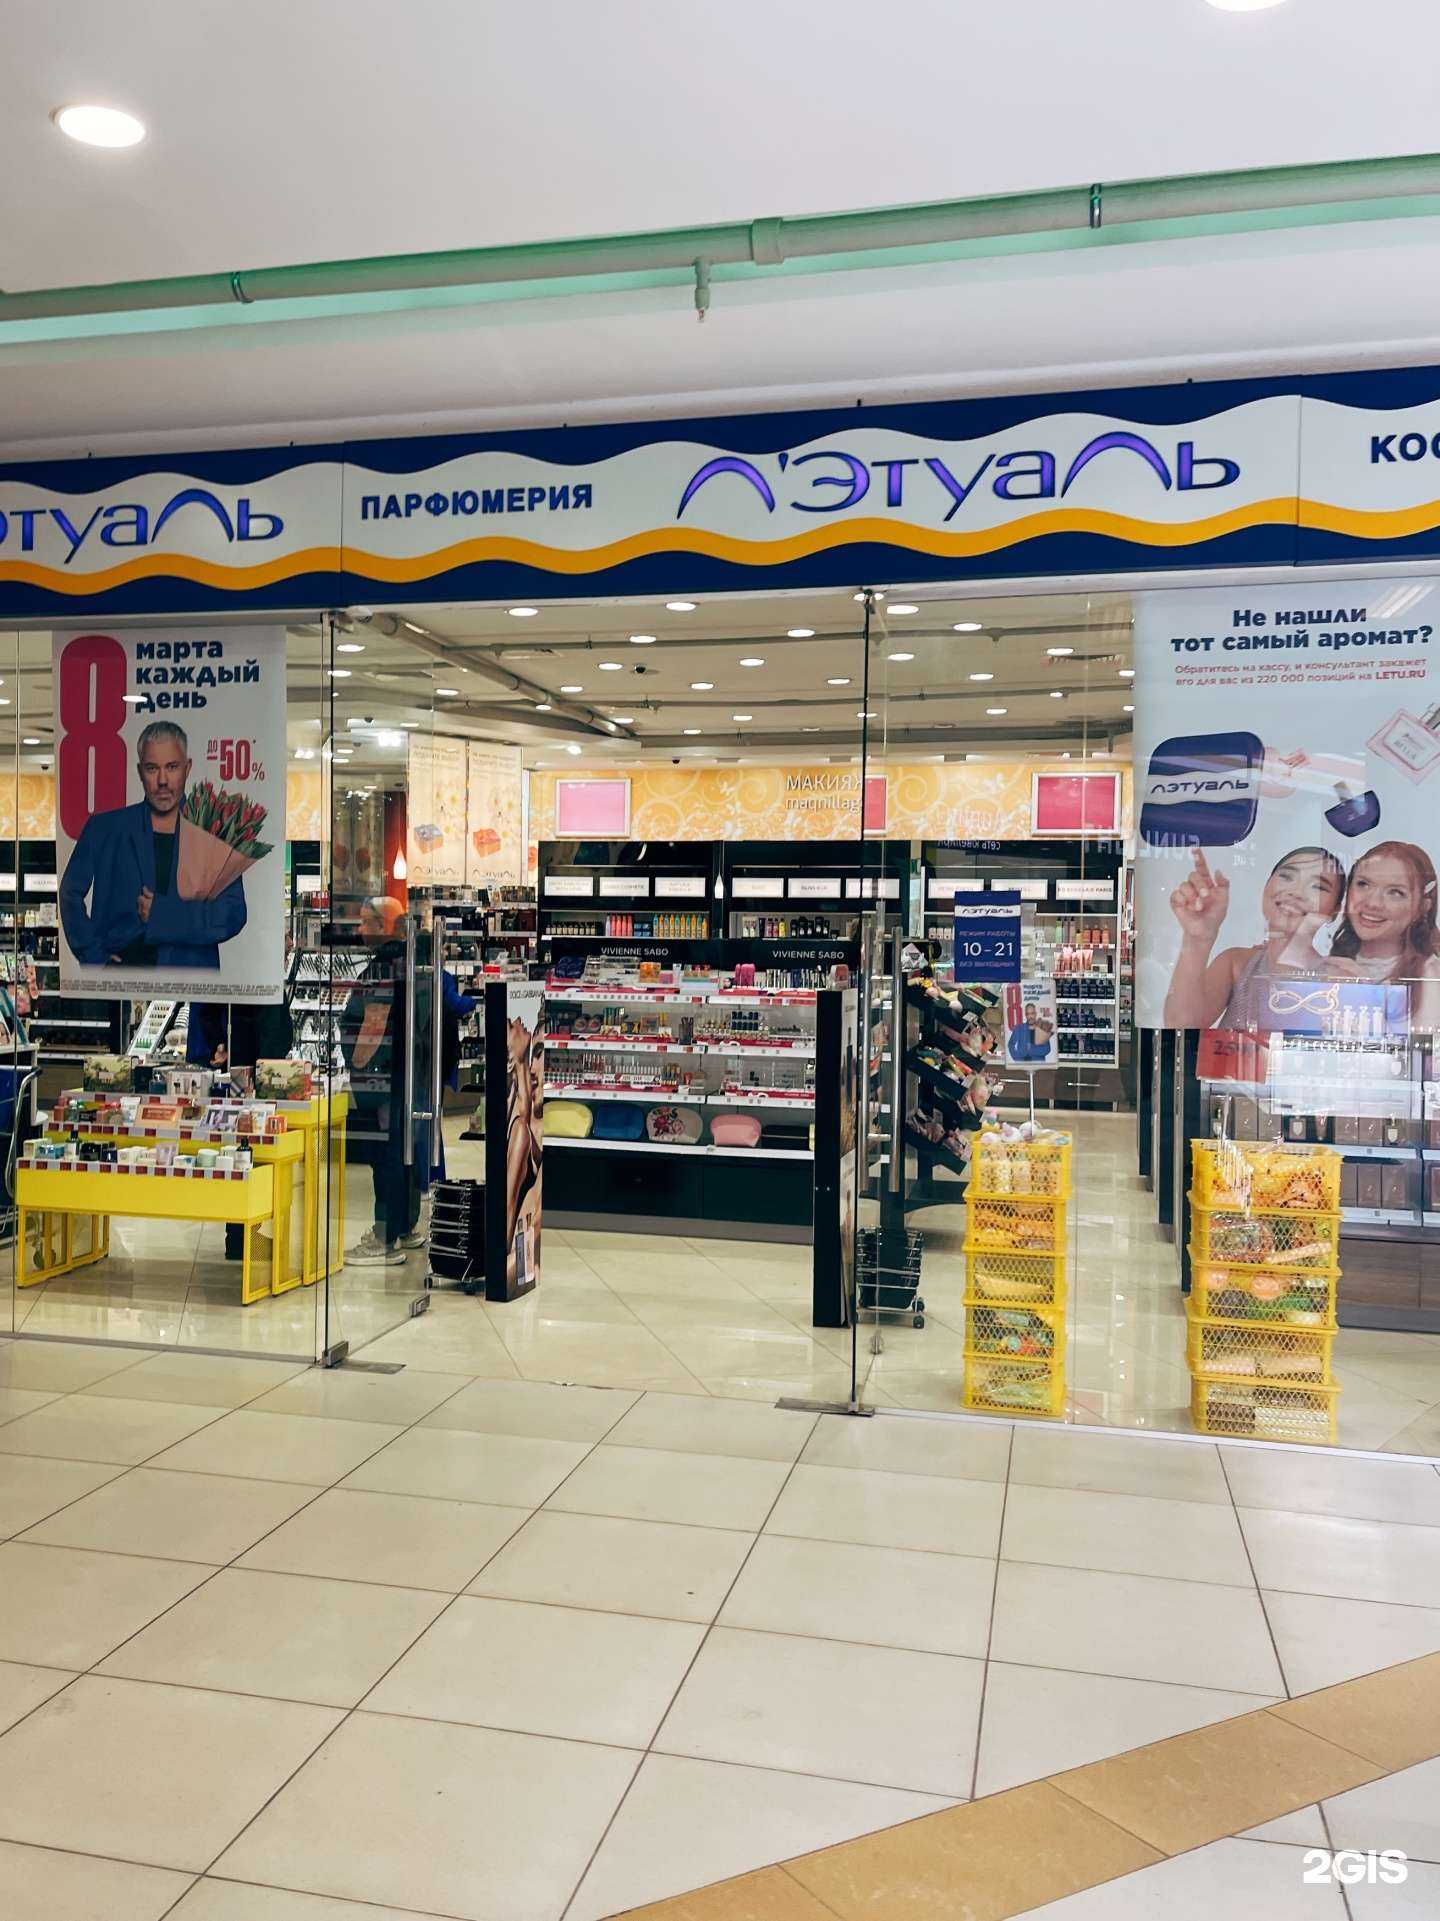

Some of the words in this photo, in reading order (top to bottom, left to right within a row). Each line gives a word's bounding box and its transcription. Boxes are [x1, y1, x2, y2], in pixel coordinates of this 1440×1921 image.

[361, 484, 593, 521] ПАРФЮМЕРИЯ
[1233, 609, 1267, 627] Не
[1275, 607, 1367, 625] нашли
[1171, 637, 1214, 652] тот
[1222, 630, 1309, 650] самый
[1318, 625, 1433, 650] аромат?
[136, 641, 223, 663] марта
[136, 659, 260, 687] каждый
[1257, 674, 1278, 683] 220
[1375, 669, 1427, 679] LETU.RU
[136, 692, 207, 713] день
[60, 635, 127, 842] 8
[601, 947, 642, 956] VIVIENNE
[643, 948, 669, 956] SABO
[772, 950, 816, 959] VIVIENNE
[818, 951, 845, 959] SABO
[963, 942, 982, 956] 10
[994, 942, 1013, 956] 21
